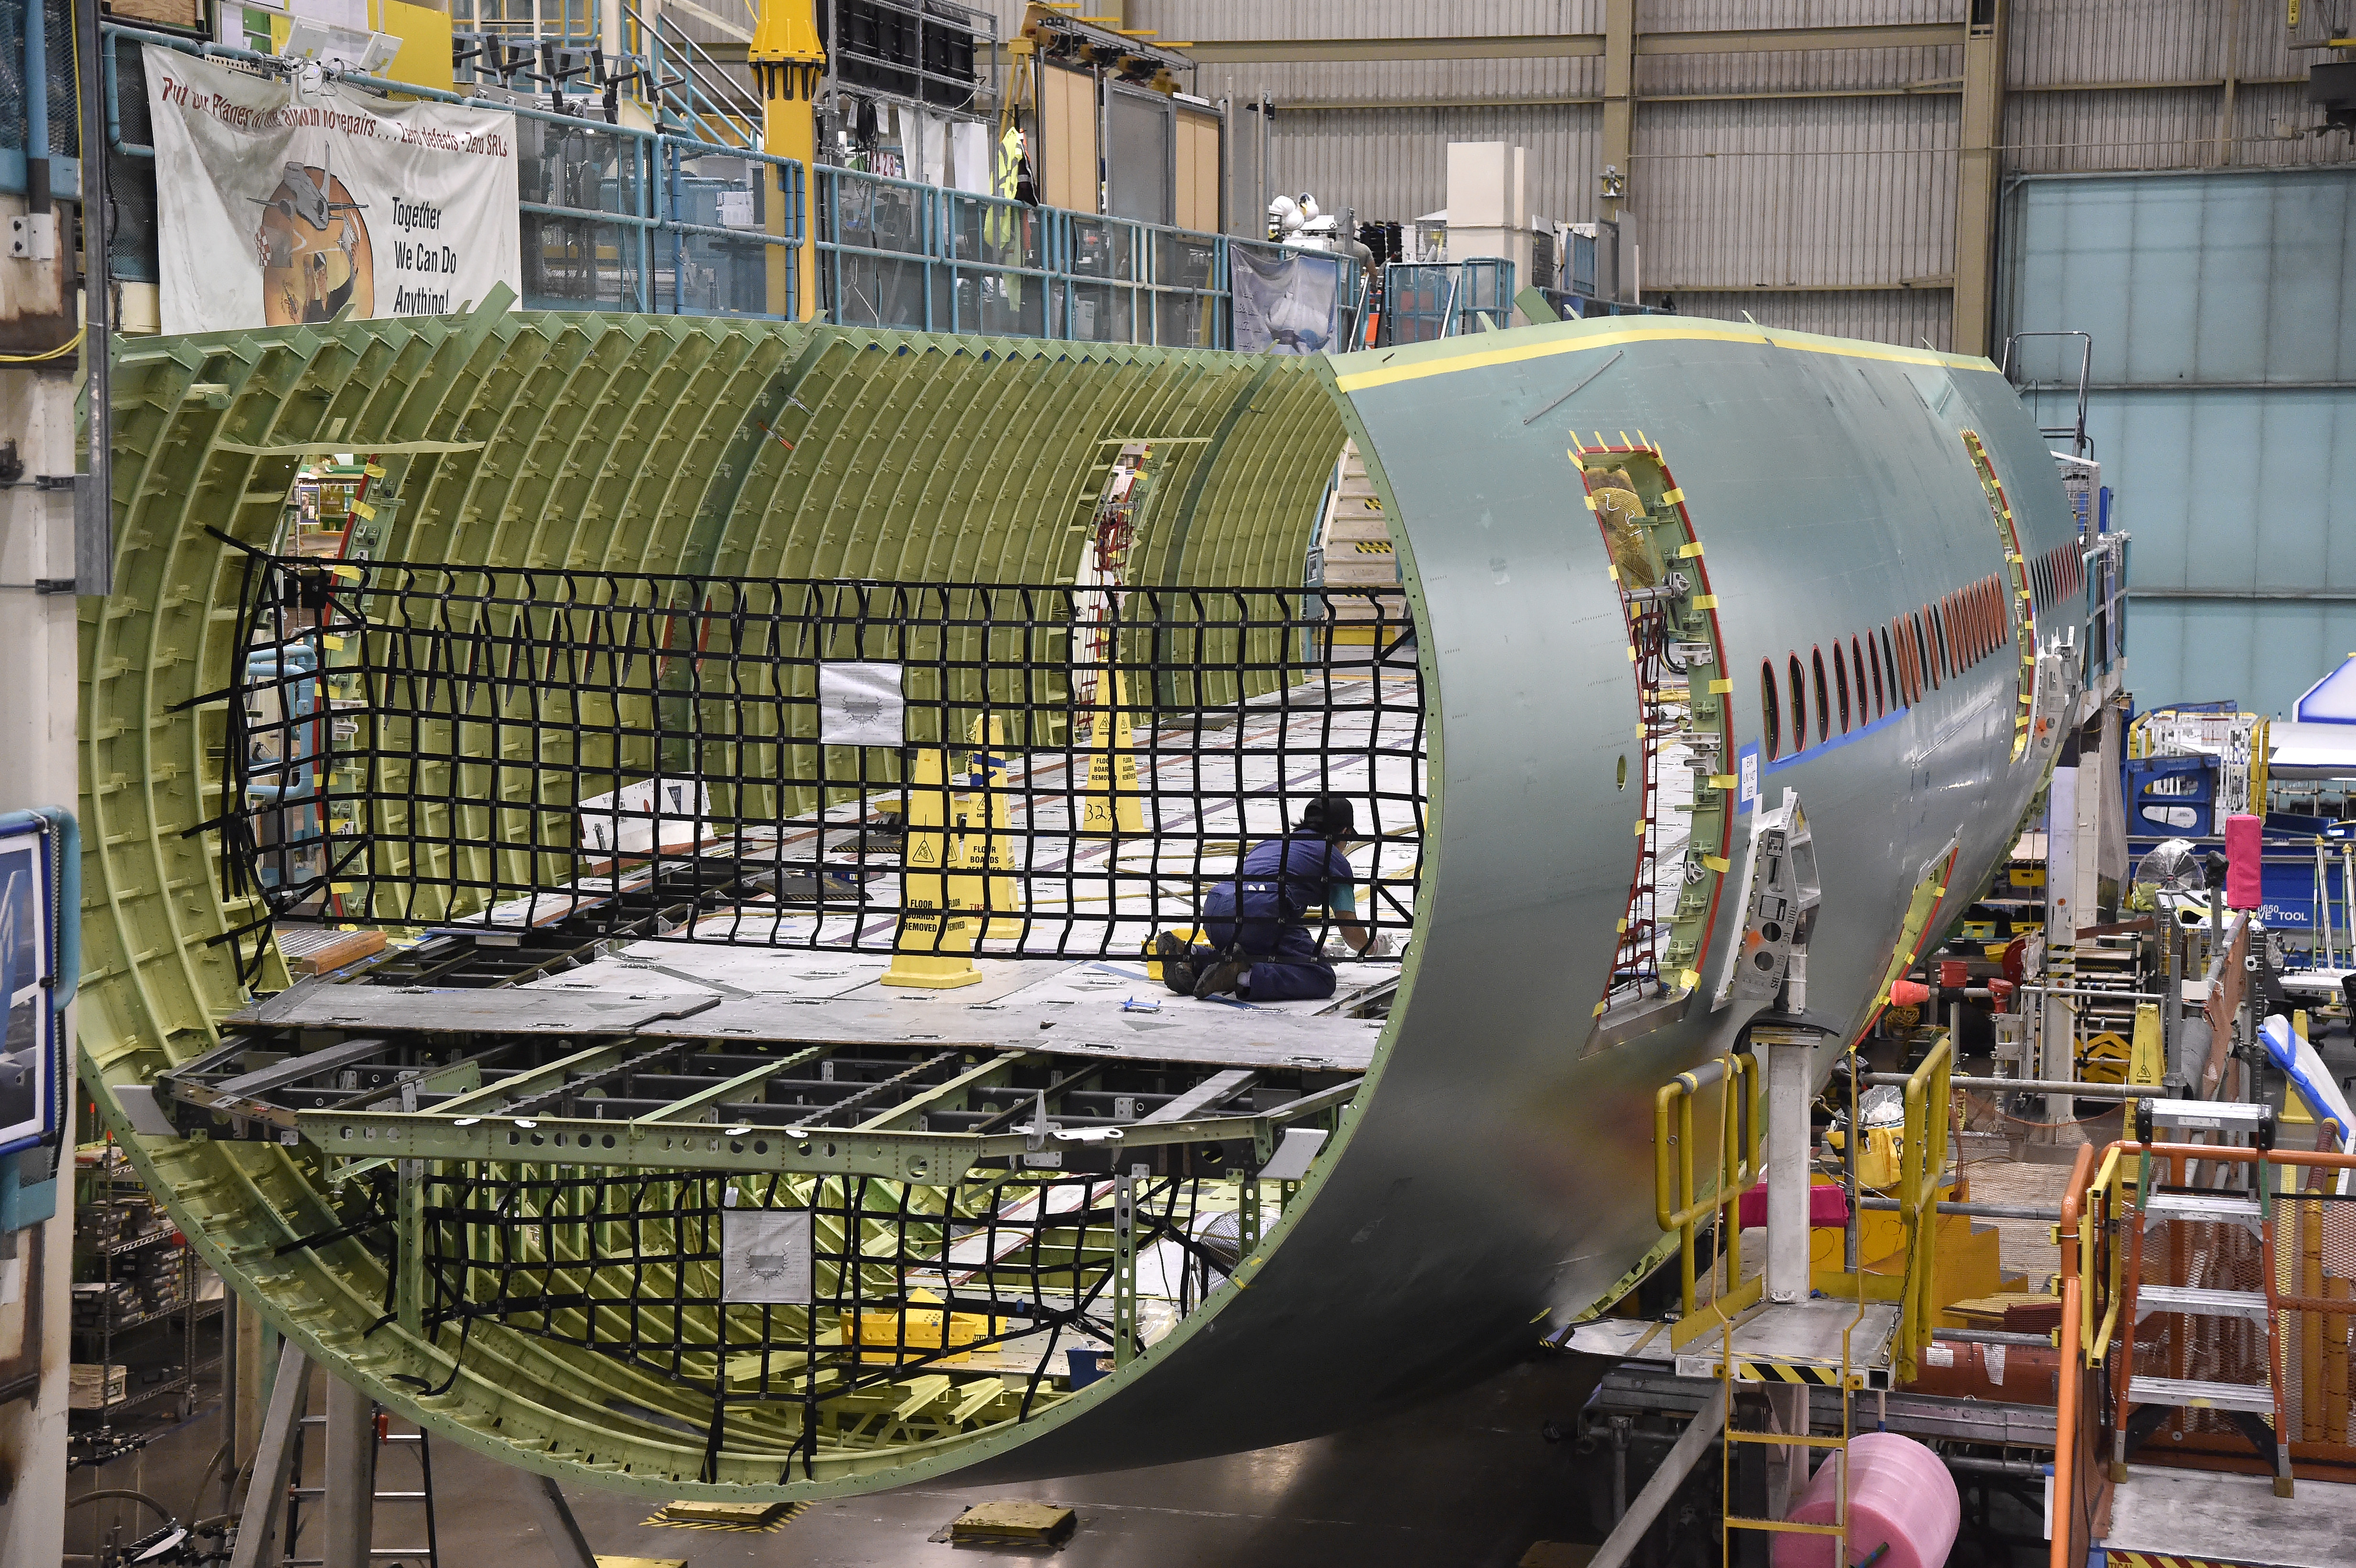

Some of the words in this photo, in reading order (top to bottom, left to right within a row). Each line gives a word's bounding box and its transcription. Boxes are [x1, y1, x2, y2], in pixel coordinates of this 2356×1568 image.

[162, 77, 188, 106] Put
[213, 93, 253, 126] Planes
[282, 104, 298, 127] air
[323, 110, 336, 129] no
[336, 113, 377, 138] repairs
[396, 122, 423, 146] Zero
[421, 127, 458, 152] defects
[465, 131, 484, 154] Zero
[487, 134, 507, 157] SRLs
[393, 196, 442, 233] Together
[394, 241, 412, 270] We
[417, 243, 438, 272] Can
[442, 246, 457, 274] Do
[393, 285, 449, 316] Anything!
[970, 856, 999, 864] BOADS
[910, 899, 933, 909] FLOOR
[2257, 912, 2272, 920] VE
[2278, 912, 2308, 921] TOOL
[904, 922, 937, 932] REMOVED
[947, 921, 965, 932] REMOVED
